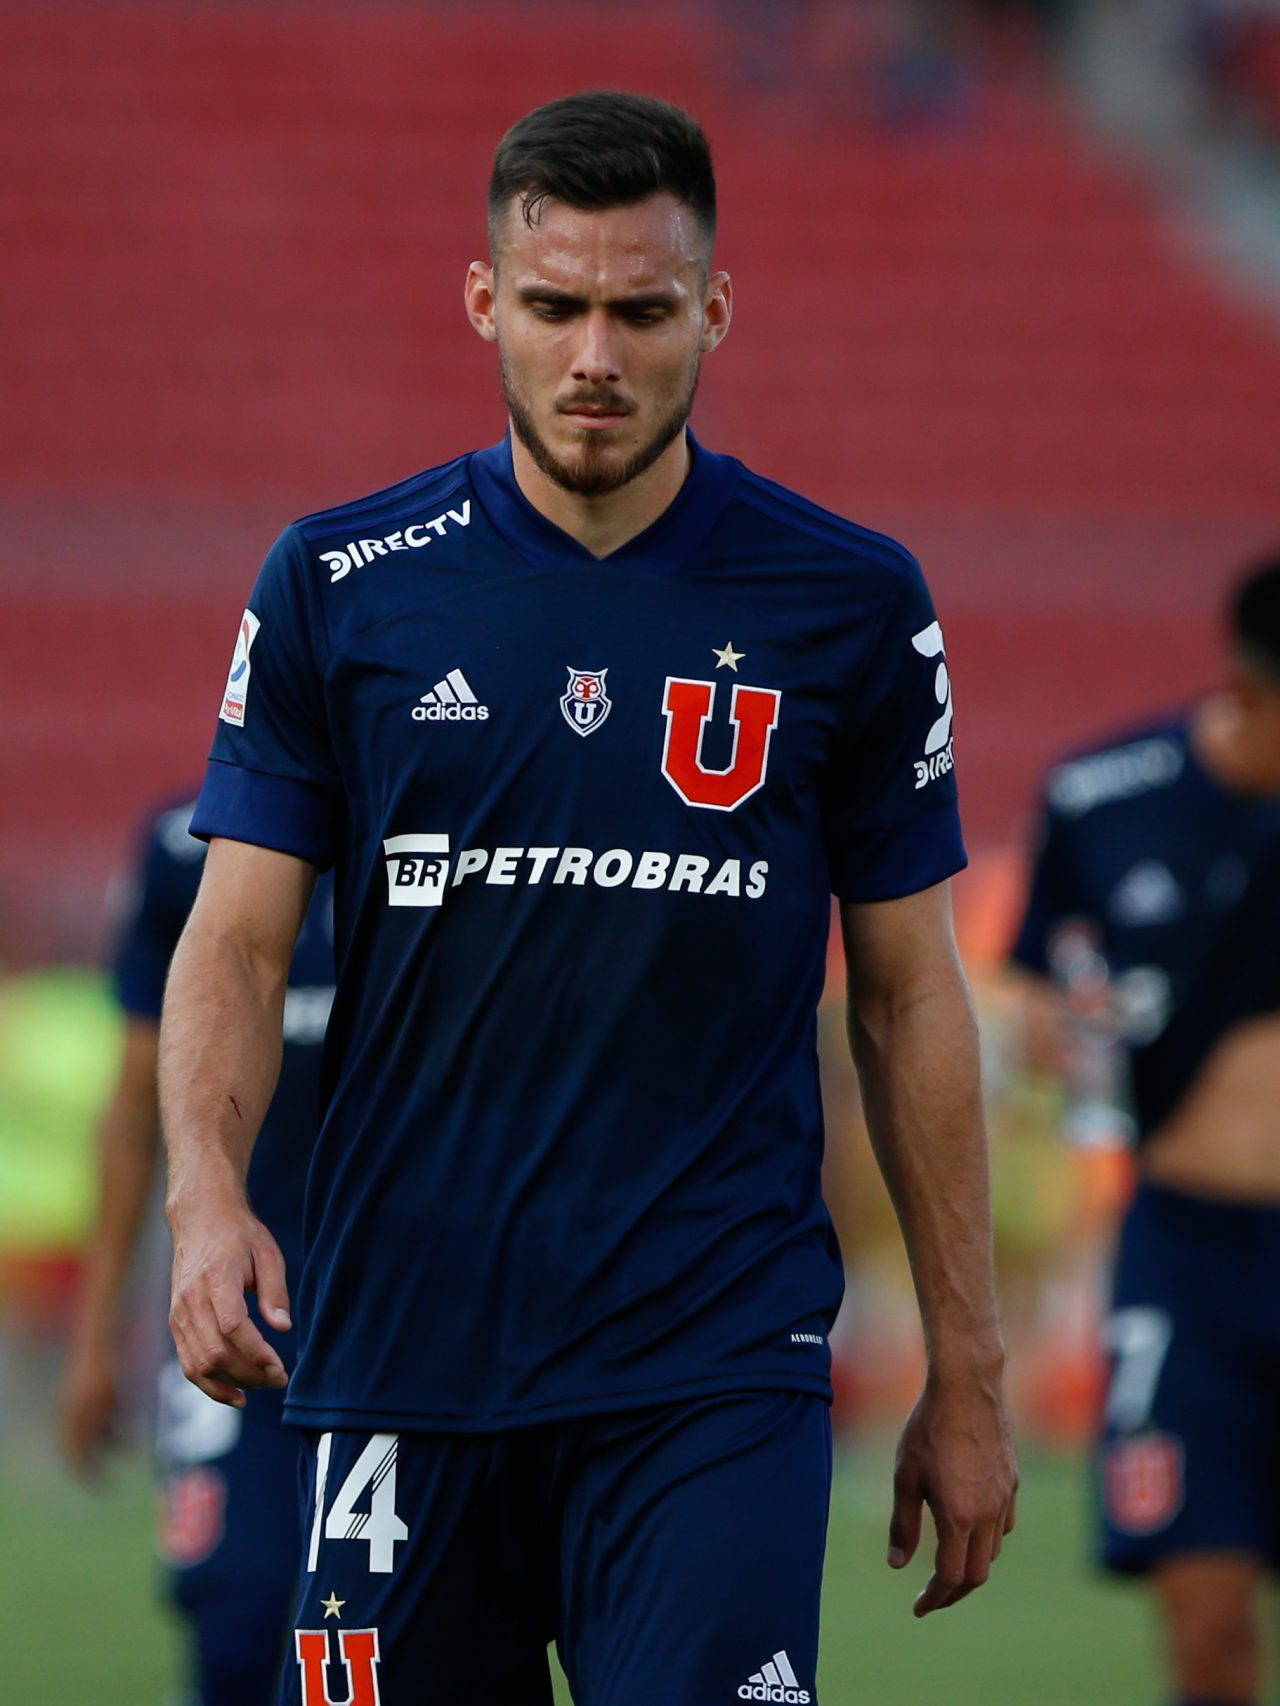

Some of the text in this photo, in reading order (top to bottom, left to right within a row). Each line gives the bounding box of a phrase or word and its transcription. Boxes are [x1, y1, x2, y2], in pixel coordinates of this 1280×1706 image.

[318, 498, 471, 584] DIRECTV
[411, 702, 490, 721] adidas
[574, 702, 597, 725] U
[660, 675, 782, 812] U
[451, 846, 769, 899] PETROBRAS
[306, 1431, 409, 1574] 14
[294, 1627, 381, 1706] U
[737, 1681, 811, 1704] adidas
